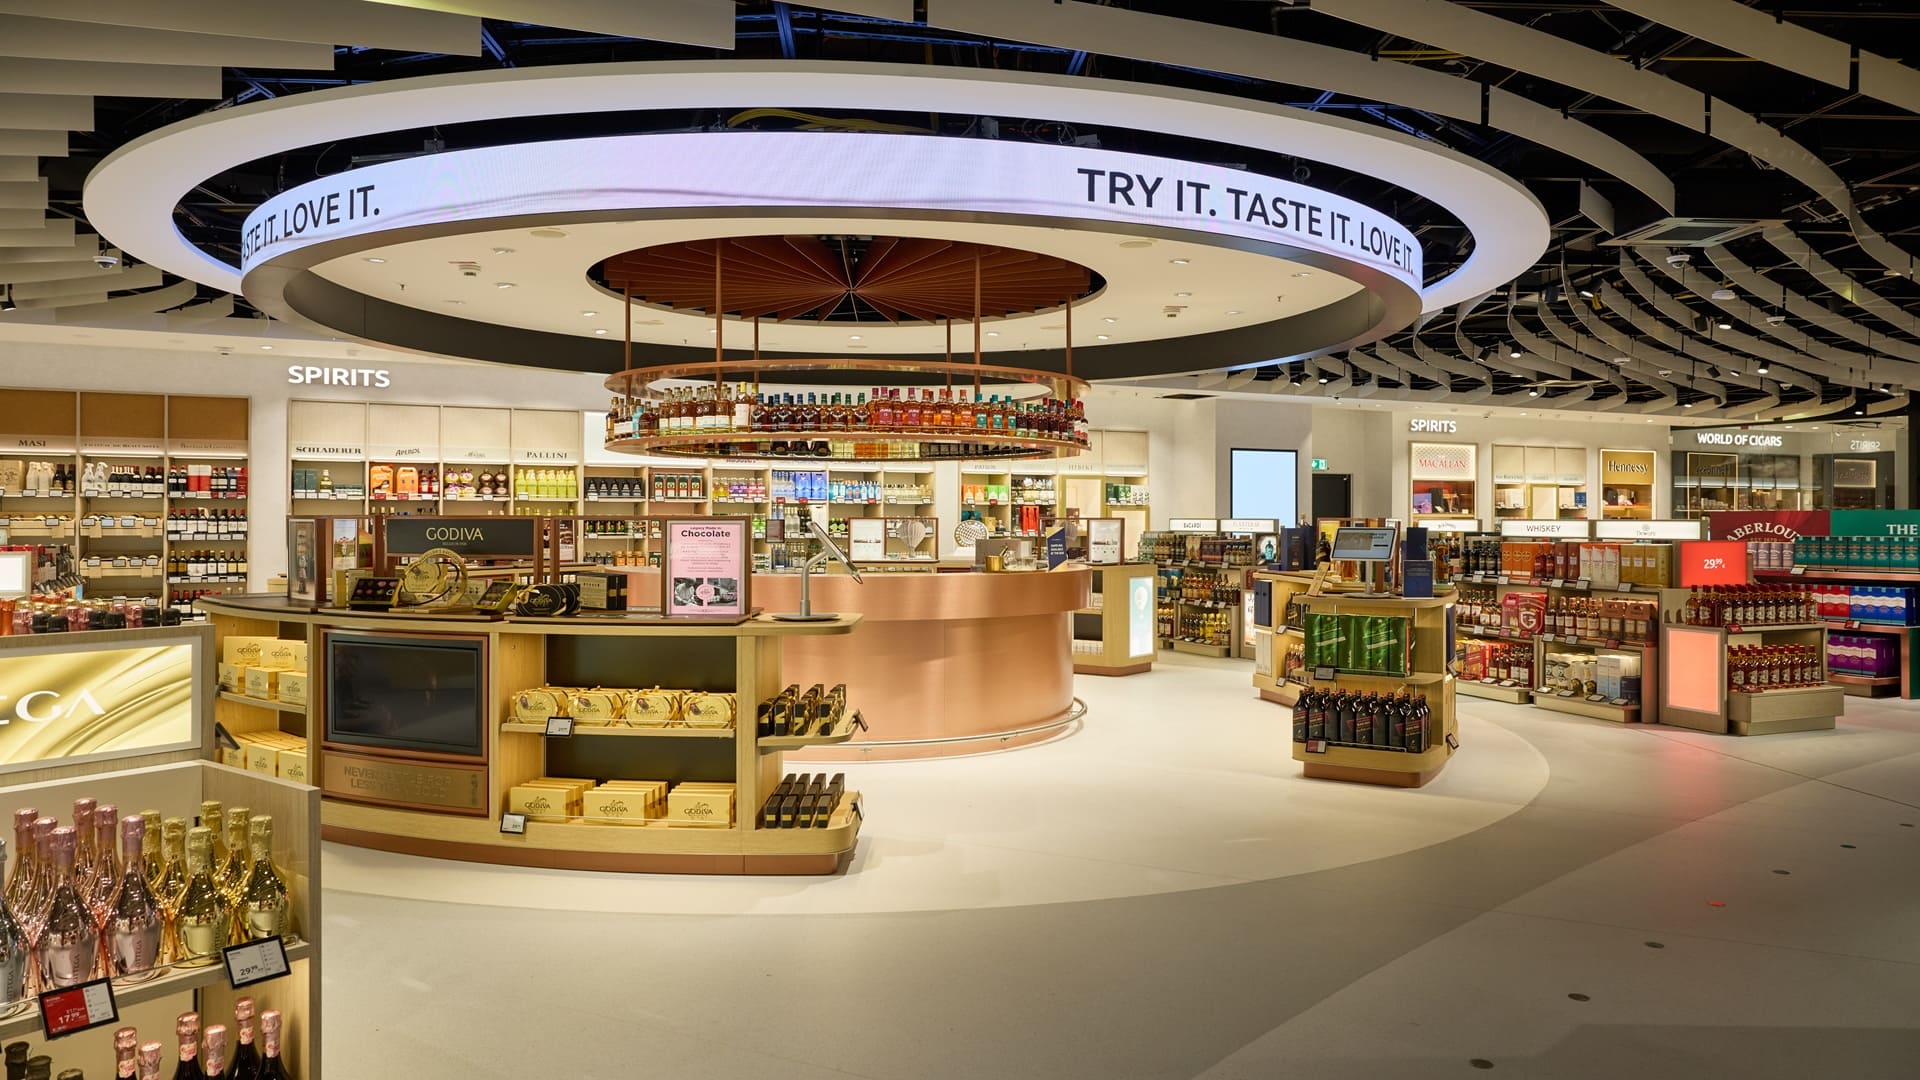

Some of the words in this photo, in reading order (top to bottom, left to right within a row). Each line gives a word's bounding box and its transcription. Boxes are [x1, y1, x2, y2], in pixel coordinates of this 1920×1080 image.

[263, 214, 279, 247] IT.
[283, 192, 341, 238] LOVE
[349, 184, 381, 220] IT.
[1077, 168, 1163, 208] TRY
[1176, 179, 1217, 217] IT.
[1226, 187, 1323, 237] TASTE
[1330, 211, 1355, 246] IT.
[1360, 221, 1401, 266] LOVE
[1403, 243, 1414, 274] IT.
[287, 364, 391, 388] SPIRITS
[1410, 418, 1457, 433] SPIRITS
[18, 439, 46, 447] MASI
[1697, 432, 1733, 444] WORLD
[1734, 434, 1749, 445] OF
[1749, 435, 1783, 447] CIGARS
[295, 446, 361, 454] SCHLADERER
[526, 451, 568, 459] PALLINI
[1419, 458, 1466, 468] MACALLAN
[1607, 460, 1649, 475] Hennessy
[1526, 524, 1561, 532] WHISKEY
[1886, 524, 1918, 535] THE
[426, 527, 484, 541] GODIVA
[525, 801, 551, 809] GODIVA
[599, 804, 629, 813] GODIVA
[684, 807, 714, 816] GODIVA
